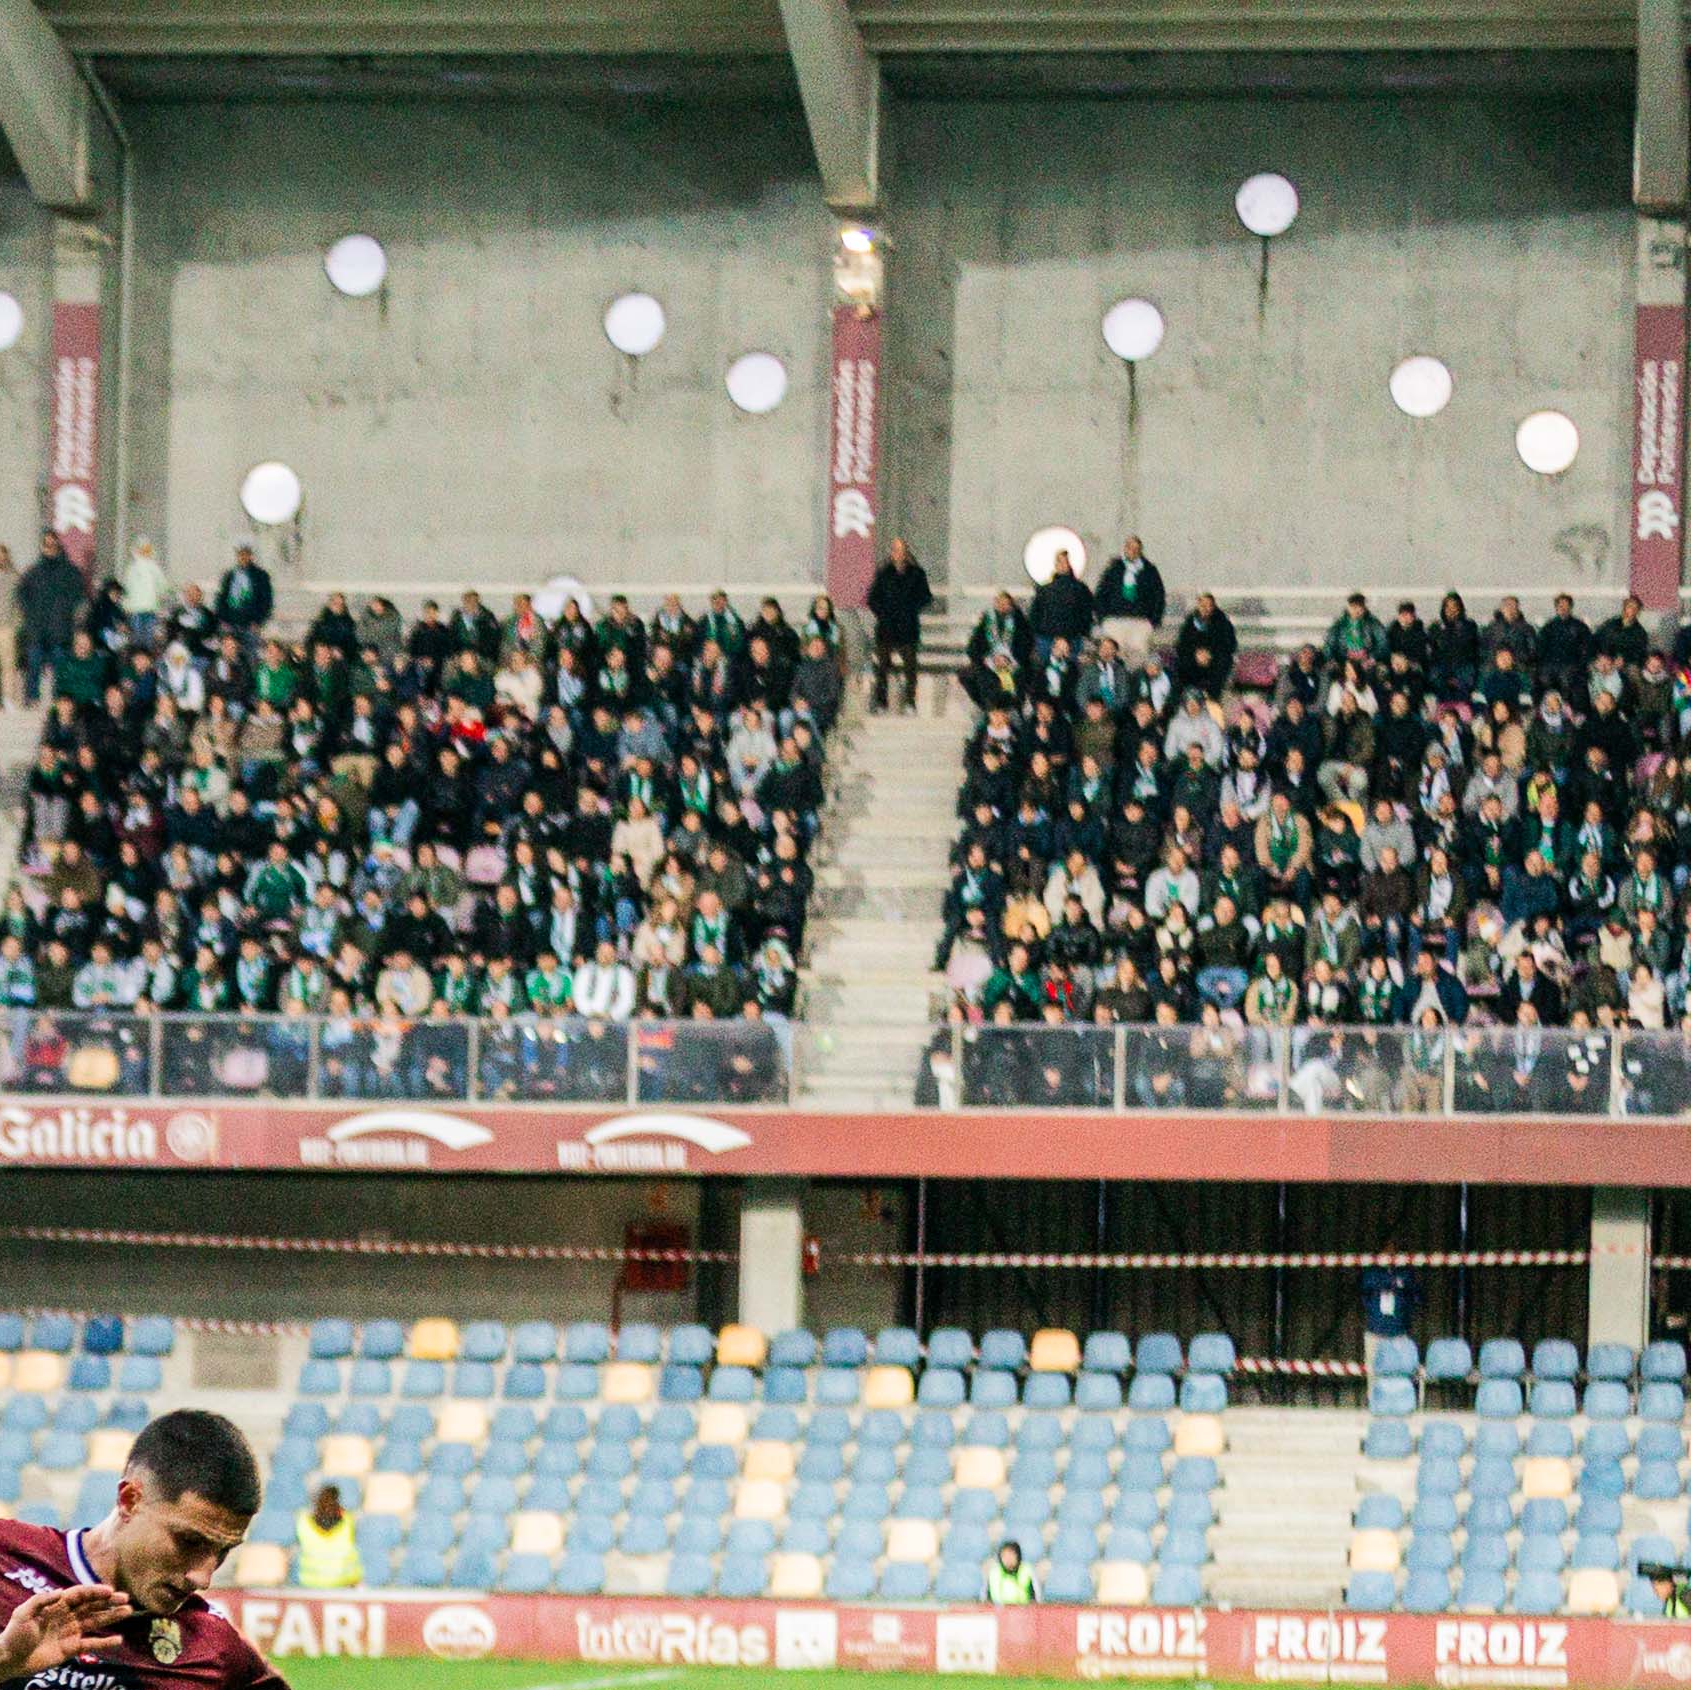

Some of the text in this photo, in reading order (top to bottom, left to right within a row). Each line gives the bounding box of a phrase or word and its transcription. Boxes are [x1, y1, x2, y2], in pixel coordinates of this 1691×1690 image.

[1075, 1613, 1207, 1657] FROIZ
[1254, 1616, 1388, 1661] FROIZ
[1435, 1621, 1568, 1665] FROIZ
